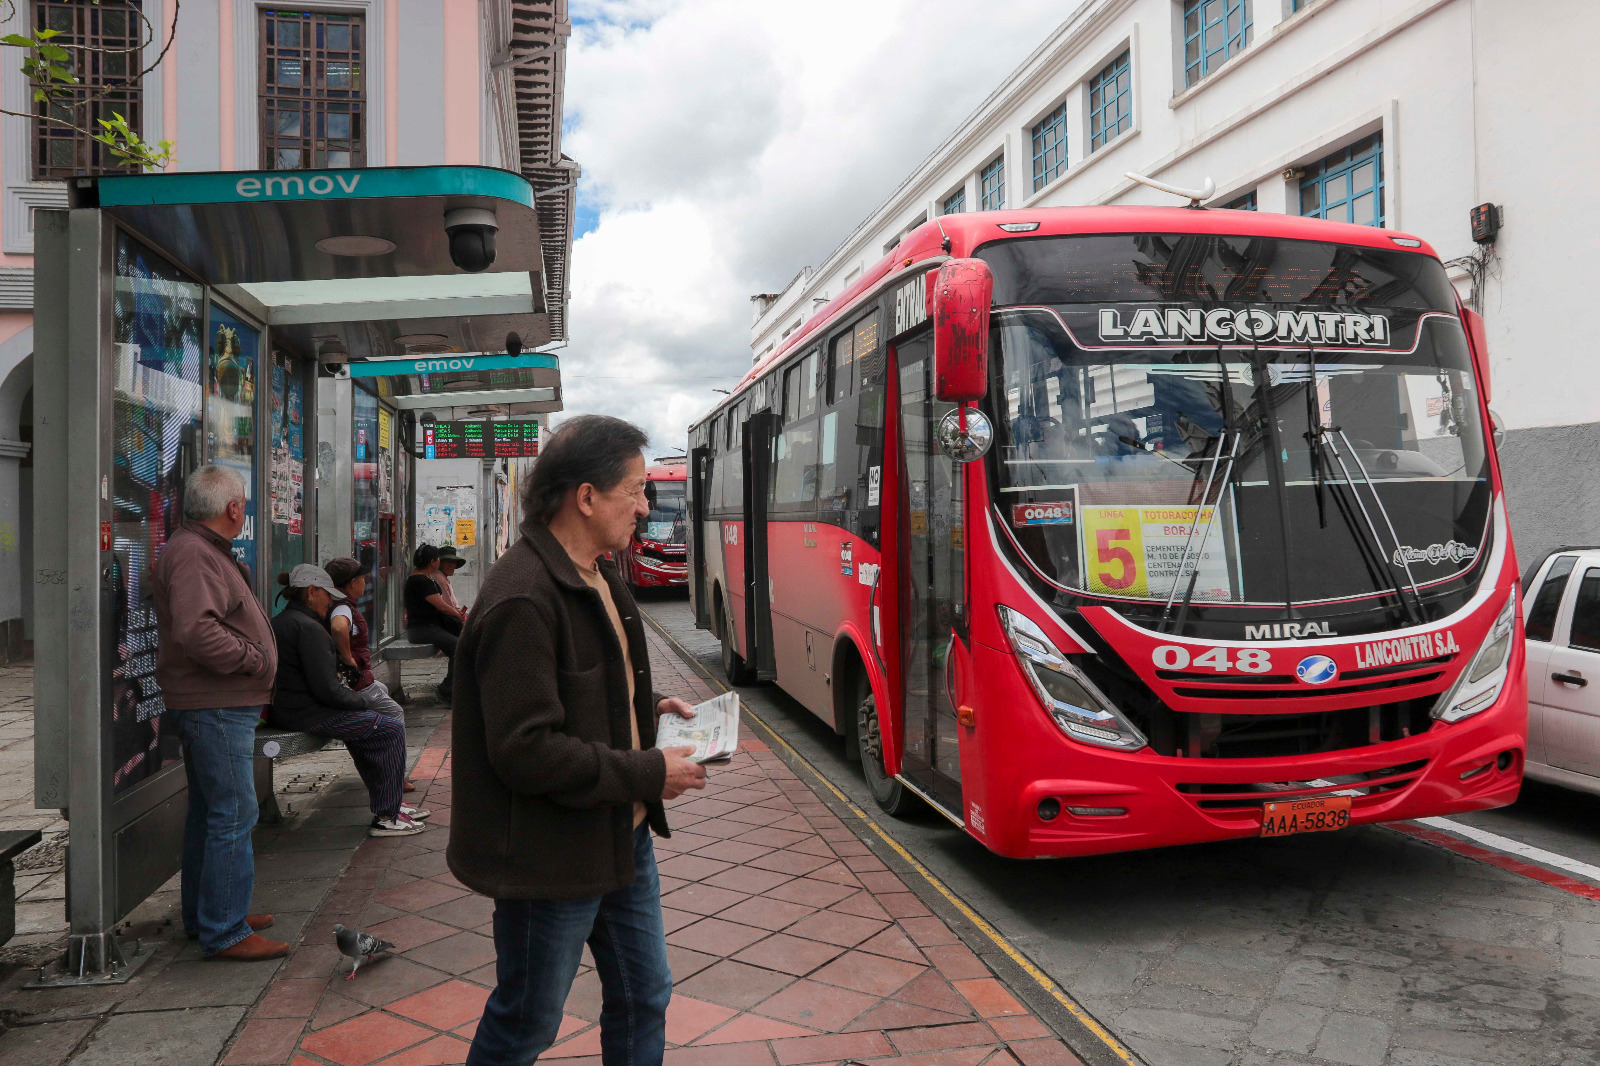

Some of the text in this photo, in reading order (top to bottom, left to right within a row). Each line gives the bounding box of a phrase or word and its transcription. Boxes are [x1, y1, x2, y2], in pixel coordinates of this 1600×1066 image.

[236, 174, 361, 198] emov
[896, 273, 927, 336] ENTRAD
[1099, 308, 1391, 346] LANCOMTRI
[414, 358, 475, 371] emov
[1025, 507, 1062, 519] 0048
[649, 526, 658, 538] 3
[724, 525, 738, 545] 048
[1164, 525, 1200, 535] BORJA
[1096, 528, 1136, 589] 5
[1245, 621, 1338, 640] MIRAL
[1152, 645, 1272, 673] 048
[1354, 630, 1460, 669] LANCOMTRI S.A.
[1292, 800, 1325, 810] ECUADOR
[1265, 809, 1348, 834] AAA-5838
